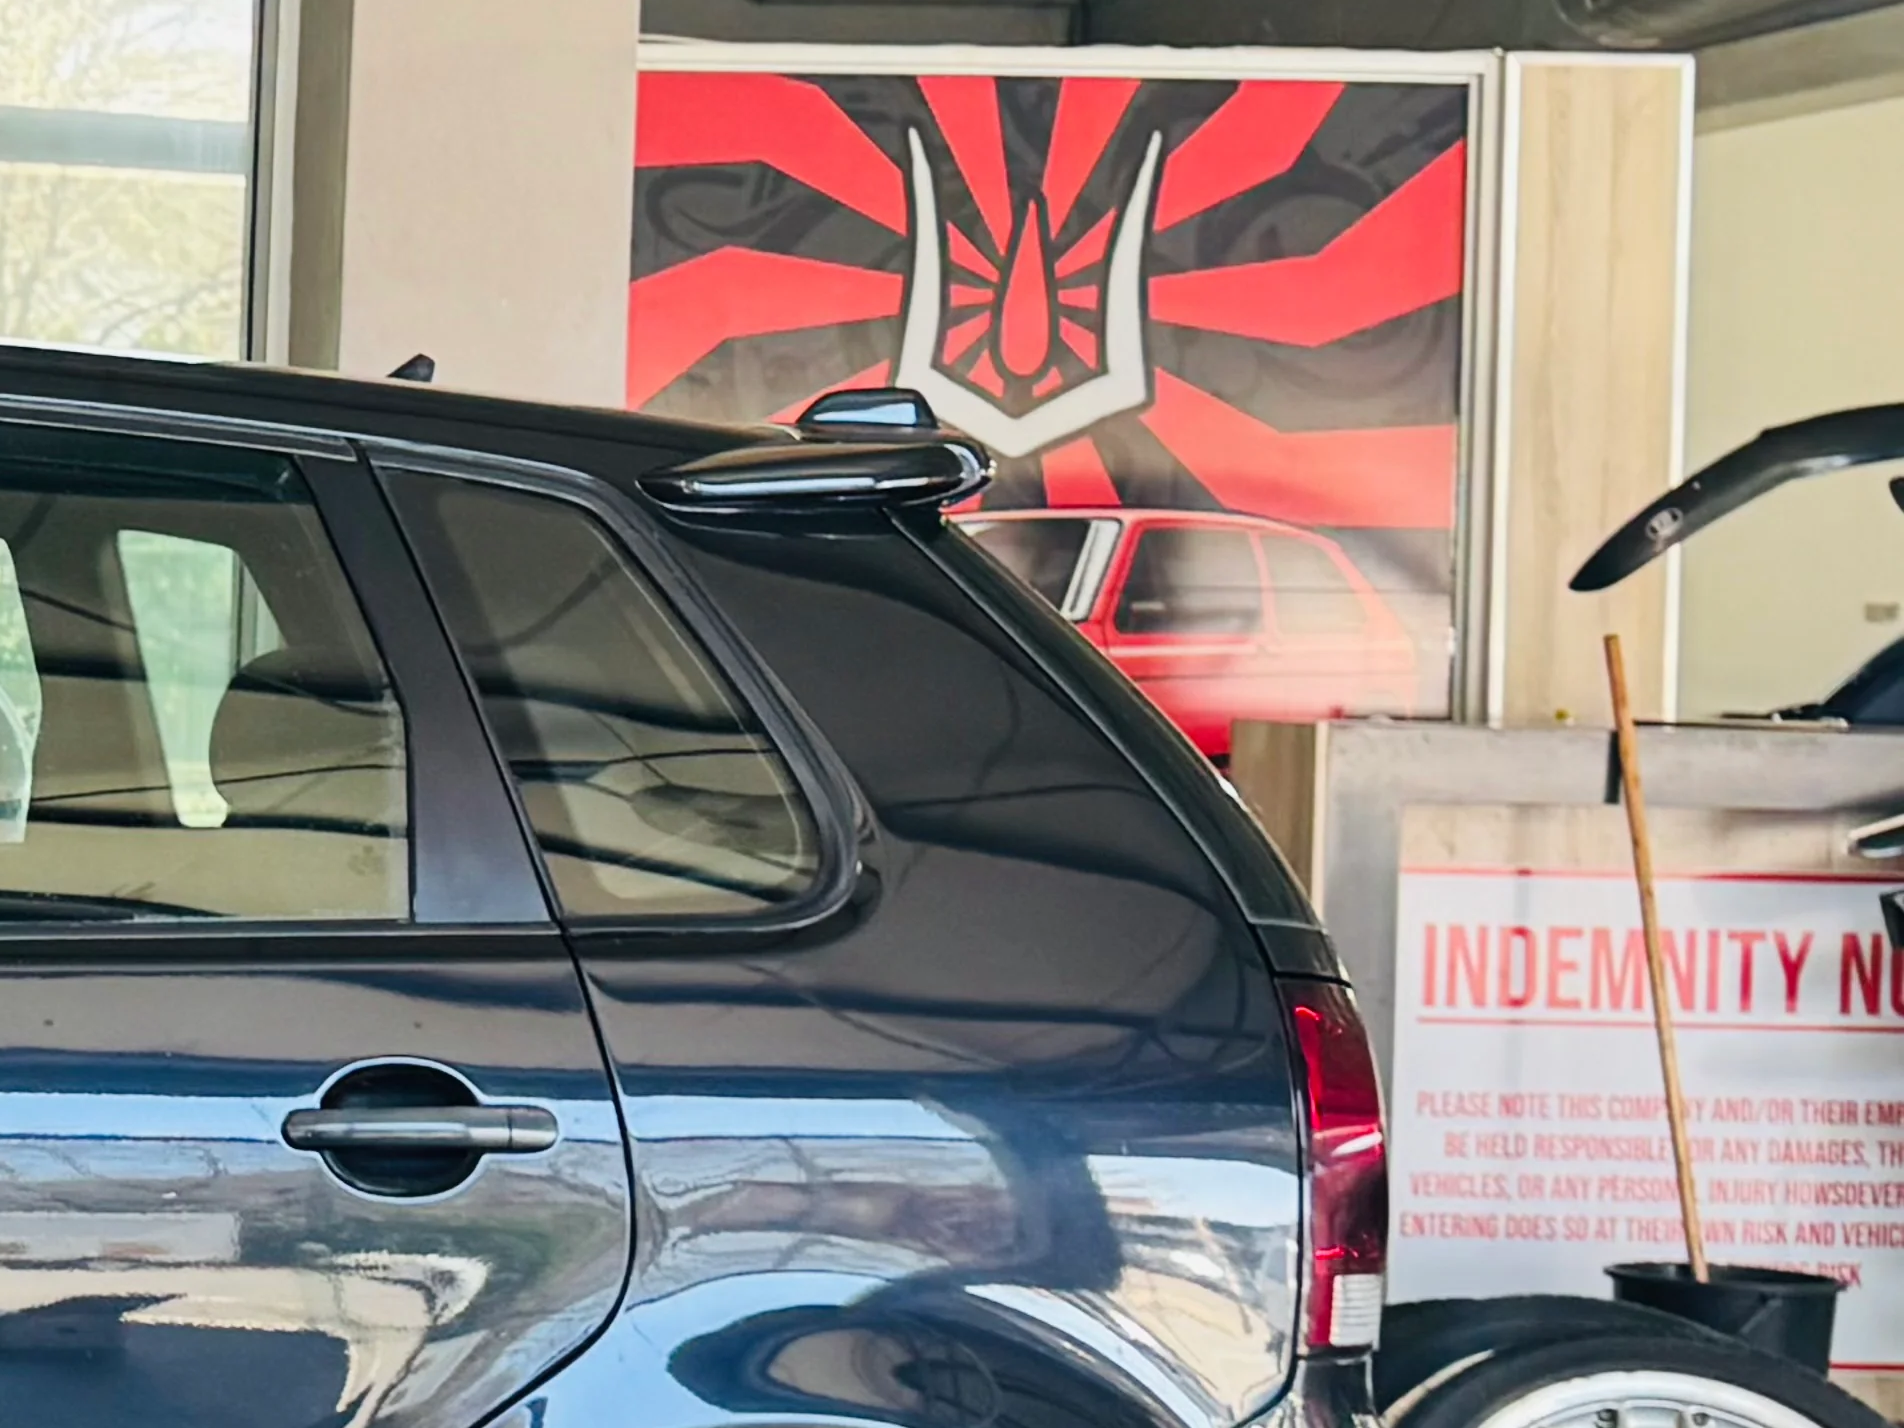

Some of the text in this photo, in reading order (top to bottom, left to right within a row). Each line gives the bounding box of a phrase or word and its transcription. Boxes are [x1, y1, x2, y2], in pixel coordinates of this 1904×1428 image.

[1422, 924, 1814, 1014] INDEMNITY
[1416, 1091, 1491, 1118] PLEASE
[1498, 1092, 1550, 1119] NOTE
[1558, 1093, 1602, 1119] THIS
[1607, 1094, 1706, 1123] COMPY
[1800, 1098, 1858, 1126] THEIR
[1445, 1132, 1469, 1159] BE
[1476, 1132, 1528, 1159] HELD
[1533, 1134, 1668, 1162] RESPONSIBLE
[1684, 1137, 1714, 1164] OR
[1720, 1137, 1761, 1165] ANY
[1516, 1174, 1544, 1200] OR
[1550, 1174, 1591, 1201] ANY
[1597, 1175, 1695, 1203] PERSON
[1708, 1177, 1777, 1206] INJURY
[1785, 1178, 1904, 1209] HOWSOEVER
[1399, 1211, 1499, 1239] ENTERING
[1505, 1214, 1557, 1241] DOES
[1563, 1215, 1589, 1241] SO
[1594, 1216, 1618, 1242] AT
[1625, 1216, 1684, 1244] THEIR
[1701, 1220, 1736, 1245] WN
[1741, 1220, 1788, 1246] RISK
[1795, 1220, 1836, 1247] AND
